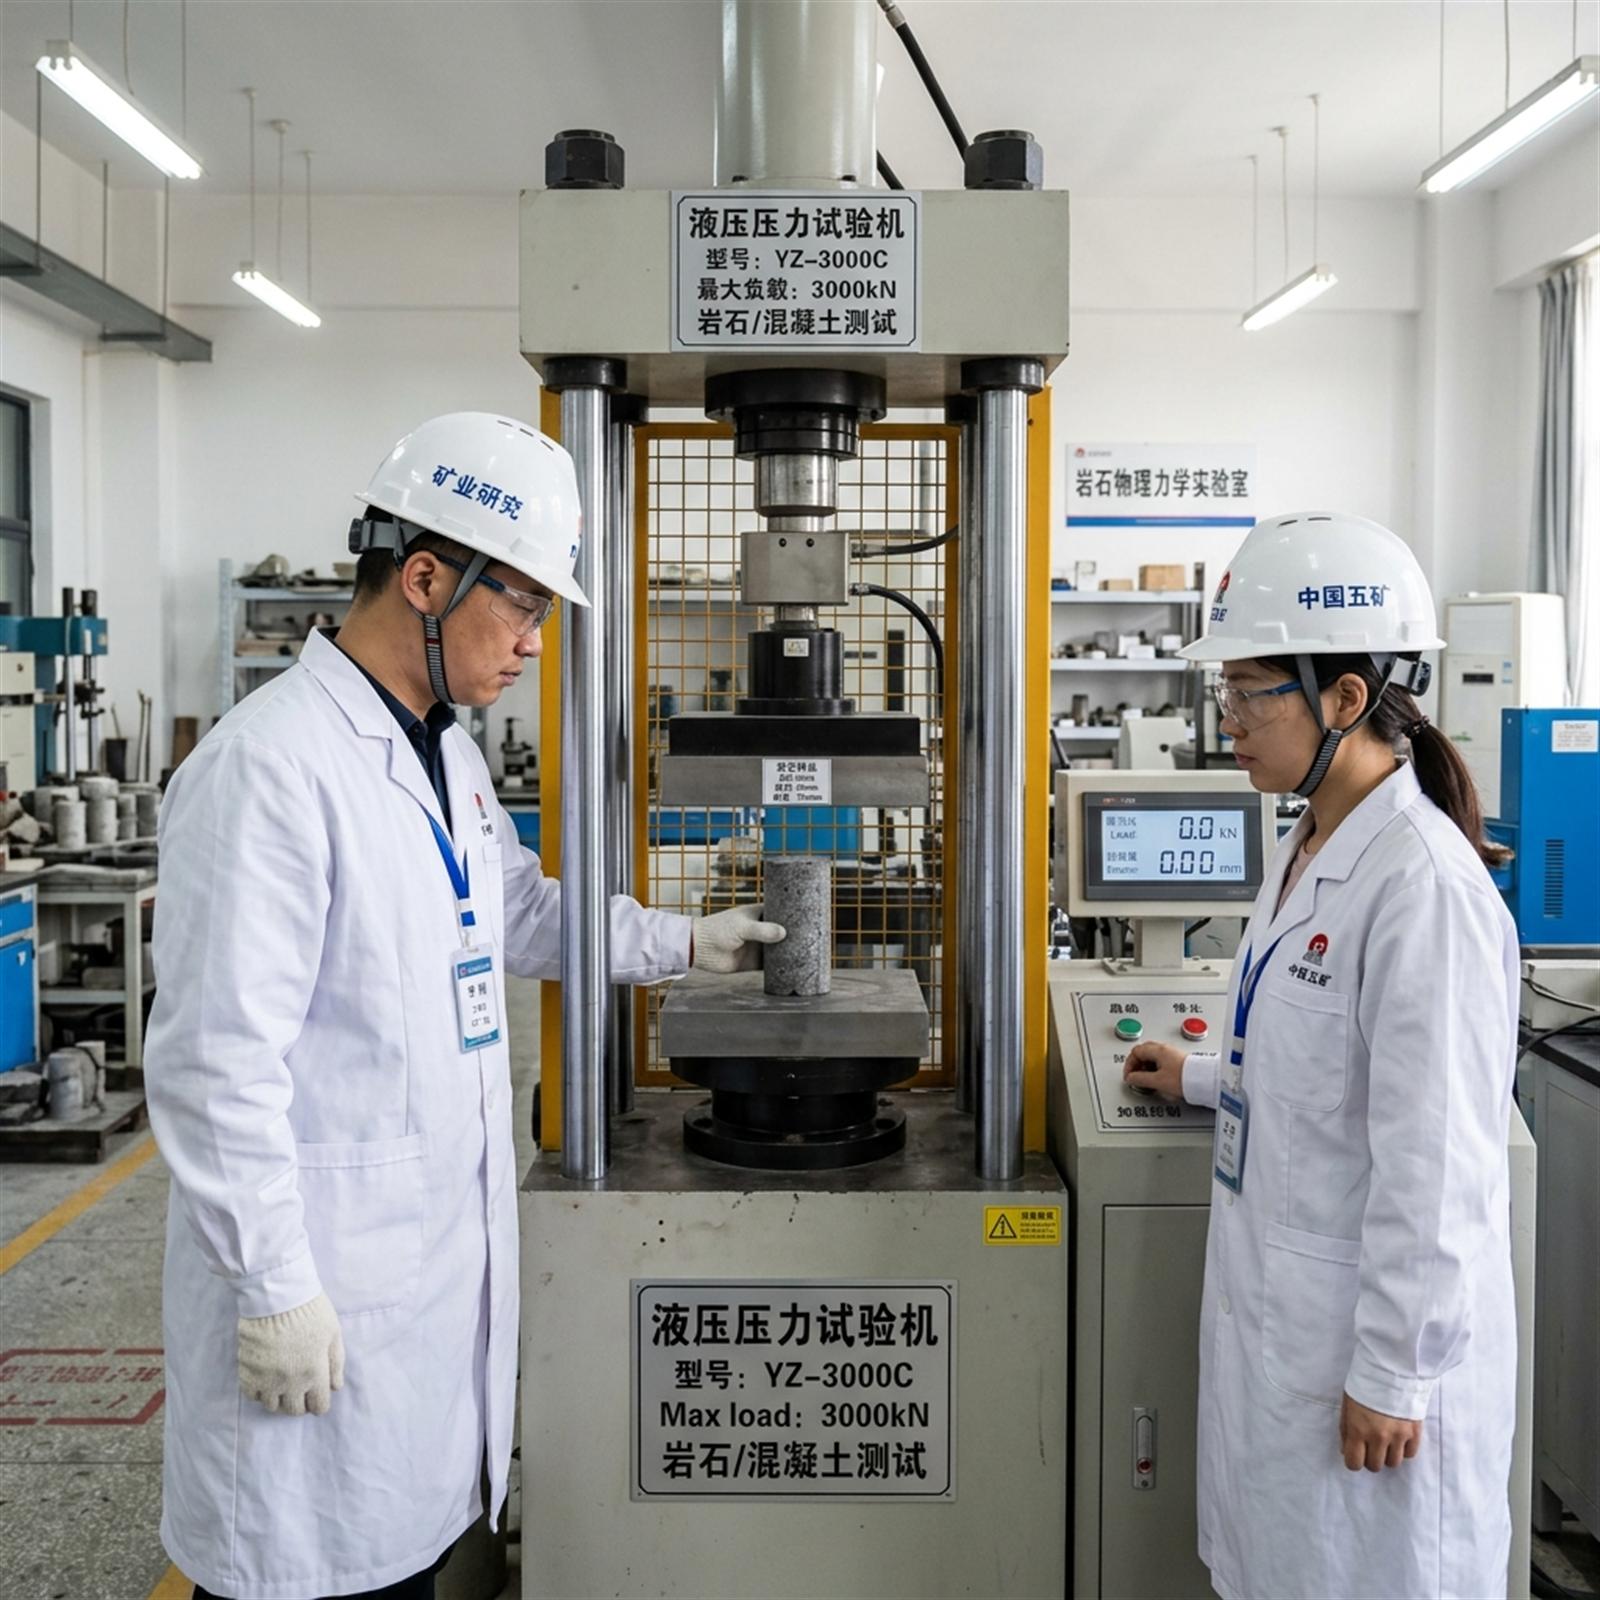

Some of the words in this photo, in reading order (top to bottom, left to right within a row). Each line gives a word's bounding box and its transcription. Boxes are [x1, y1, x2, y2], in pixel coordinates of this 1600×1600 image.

[689, 207, 905, 239] 液压压力试验机
[811, 280, 897, 299] 3000kN
[698, 308, 897, 336] 岩石/混凝土测试
[432, 465, 523, 520] 矿业研究
[1075, 468, 1249, 498] 岩石物理力学实验室
[1298, 585, 1391, 610] 中国五矿
[1179, 816, 1214, 840] 0.0
[652, 1302, 939, 1348] 液压压力试验机
[660, 1402, 721, 1427] Max
[821, 1402, 930, 1428] 3000kN
[663, 1441, 927, 1480] 岩石/混凝土测试
